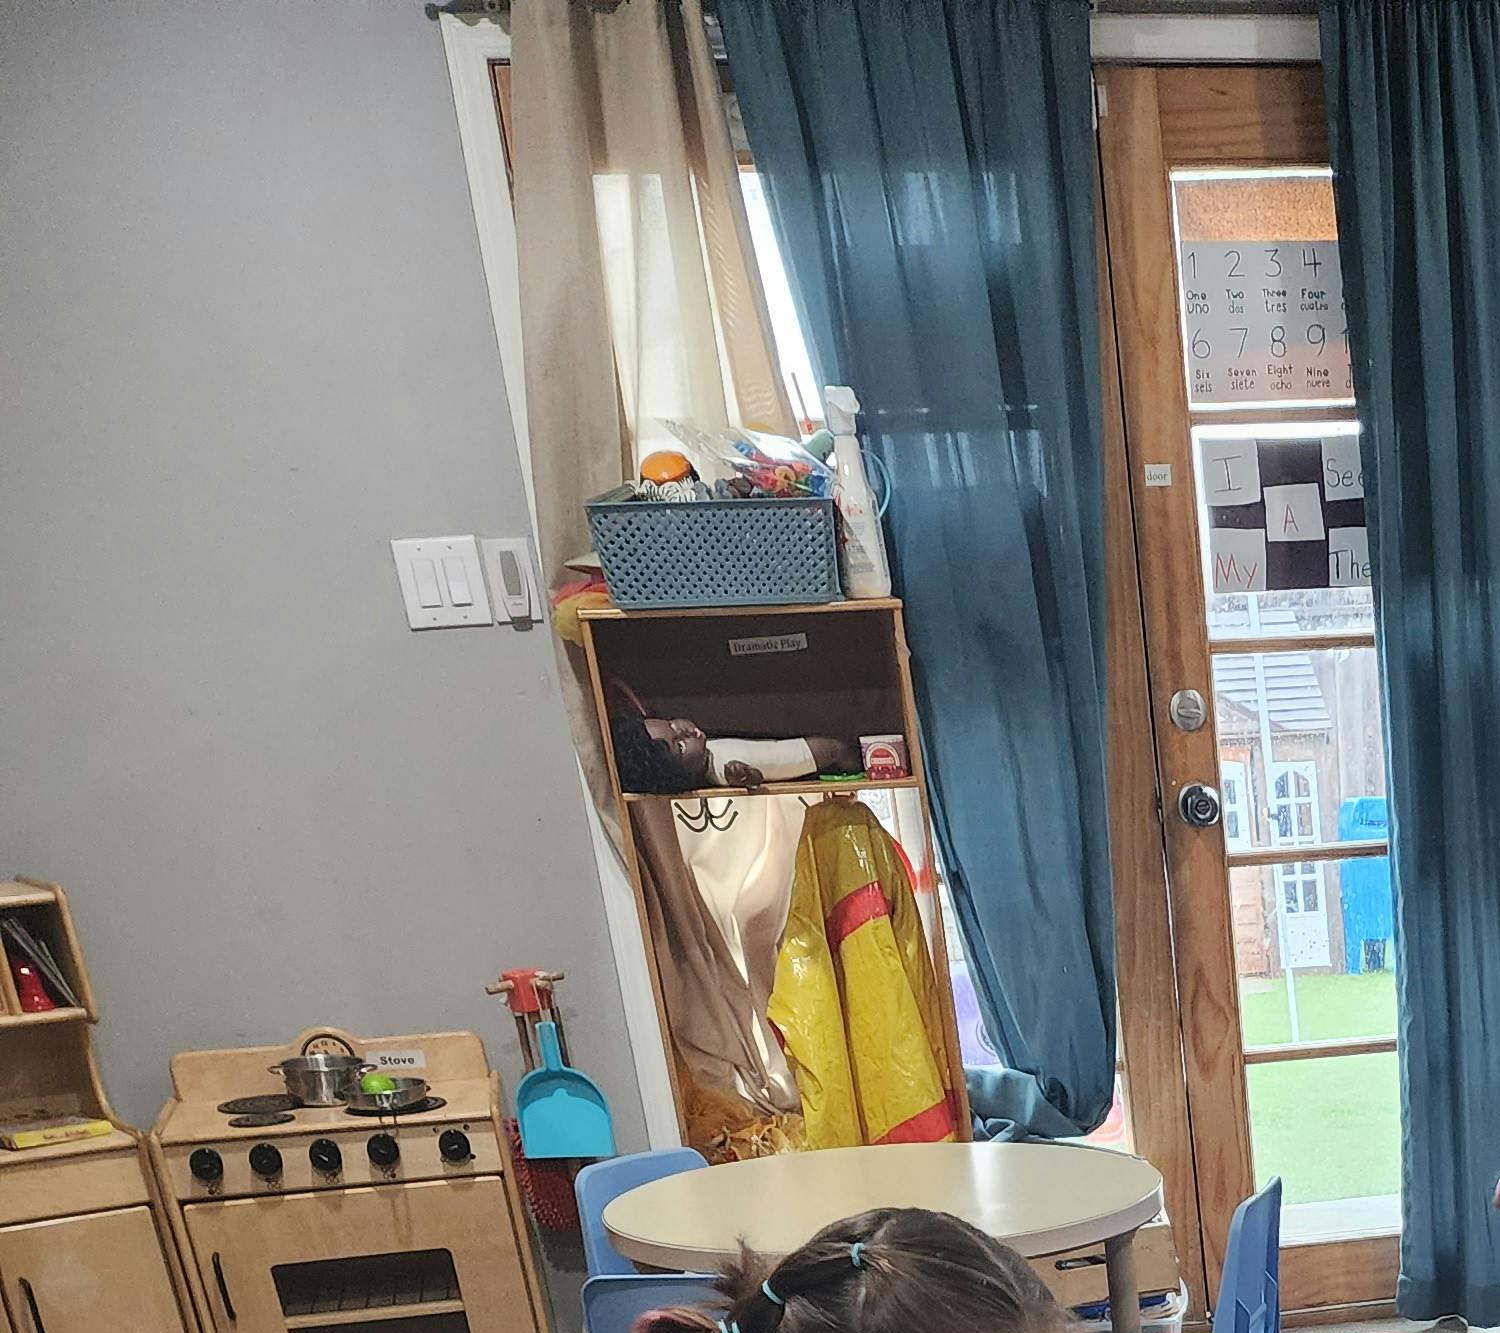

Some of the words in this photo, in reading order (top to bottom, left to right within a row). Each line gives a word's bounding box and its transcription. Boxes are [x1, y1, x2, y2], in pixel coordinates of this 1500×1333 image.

[1187, 251, 1197, 279] 1
[1224, 250, 1245, 278] 2
[1264, 248, 1283, 278] 3
[1302, 247, 1323, 278] 4
[1186, 290, 1207, 300] One
[1225, 289, 1244, 300] Two
[1262, 288, 1287, 298] Three
[1301, 288, 1326, 299] Four
[1265, 302, 1287, 313] tres
[1300, 301, 1329, 312] cuatro
[1191, 328, 1211, 359] 6
[1228, 327, 1248, 358] 7
[1270, 325, 1287, 357] 8
[1306, 324, 1326, 358] 9
[1195, 369, 1210, 380] Six
[1227, 367, 1257, 378] Seven
[1267, 364, 1294, 378] Eight
[1306, 367, 1329, 378] Nine
[1270, 379, 1292, 391] ocho
[1146, 471, 1169, 482] door
[1212, 455, 1241, 493] I
[1283, 504, 1299, 534] A
[1215, 552, 1258, 589] My
[1328, 549, 1372, 580] The
[733, 639, 778, 653] Dramatic
[781, 637, 801, 651] Play
[380, 1056, 415, 1065] Stove
